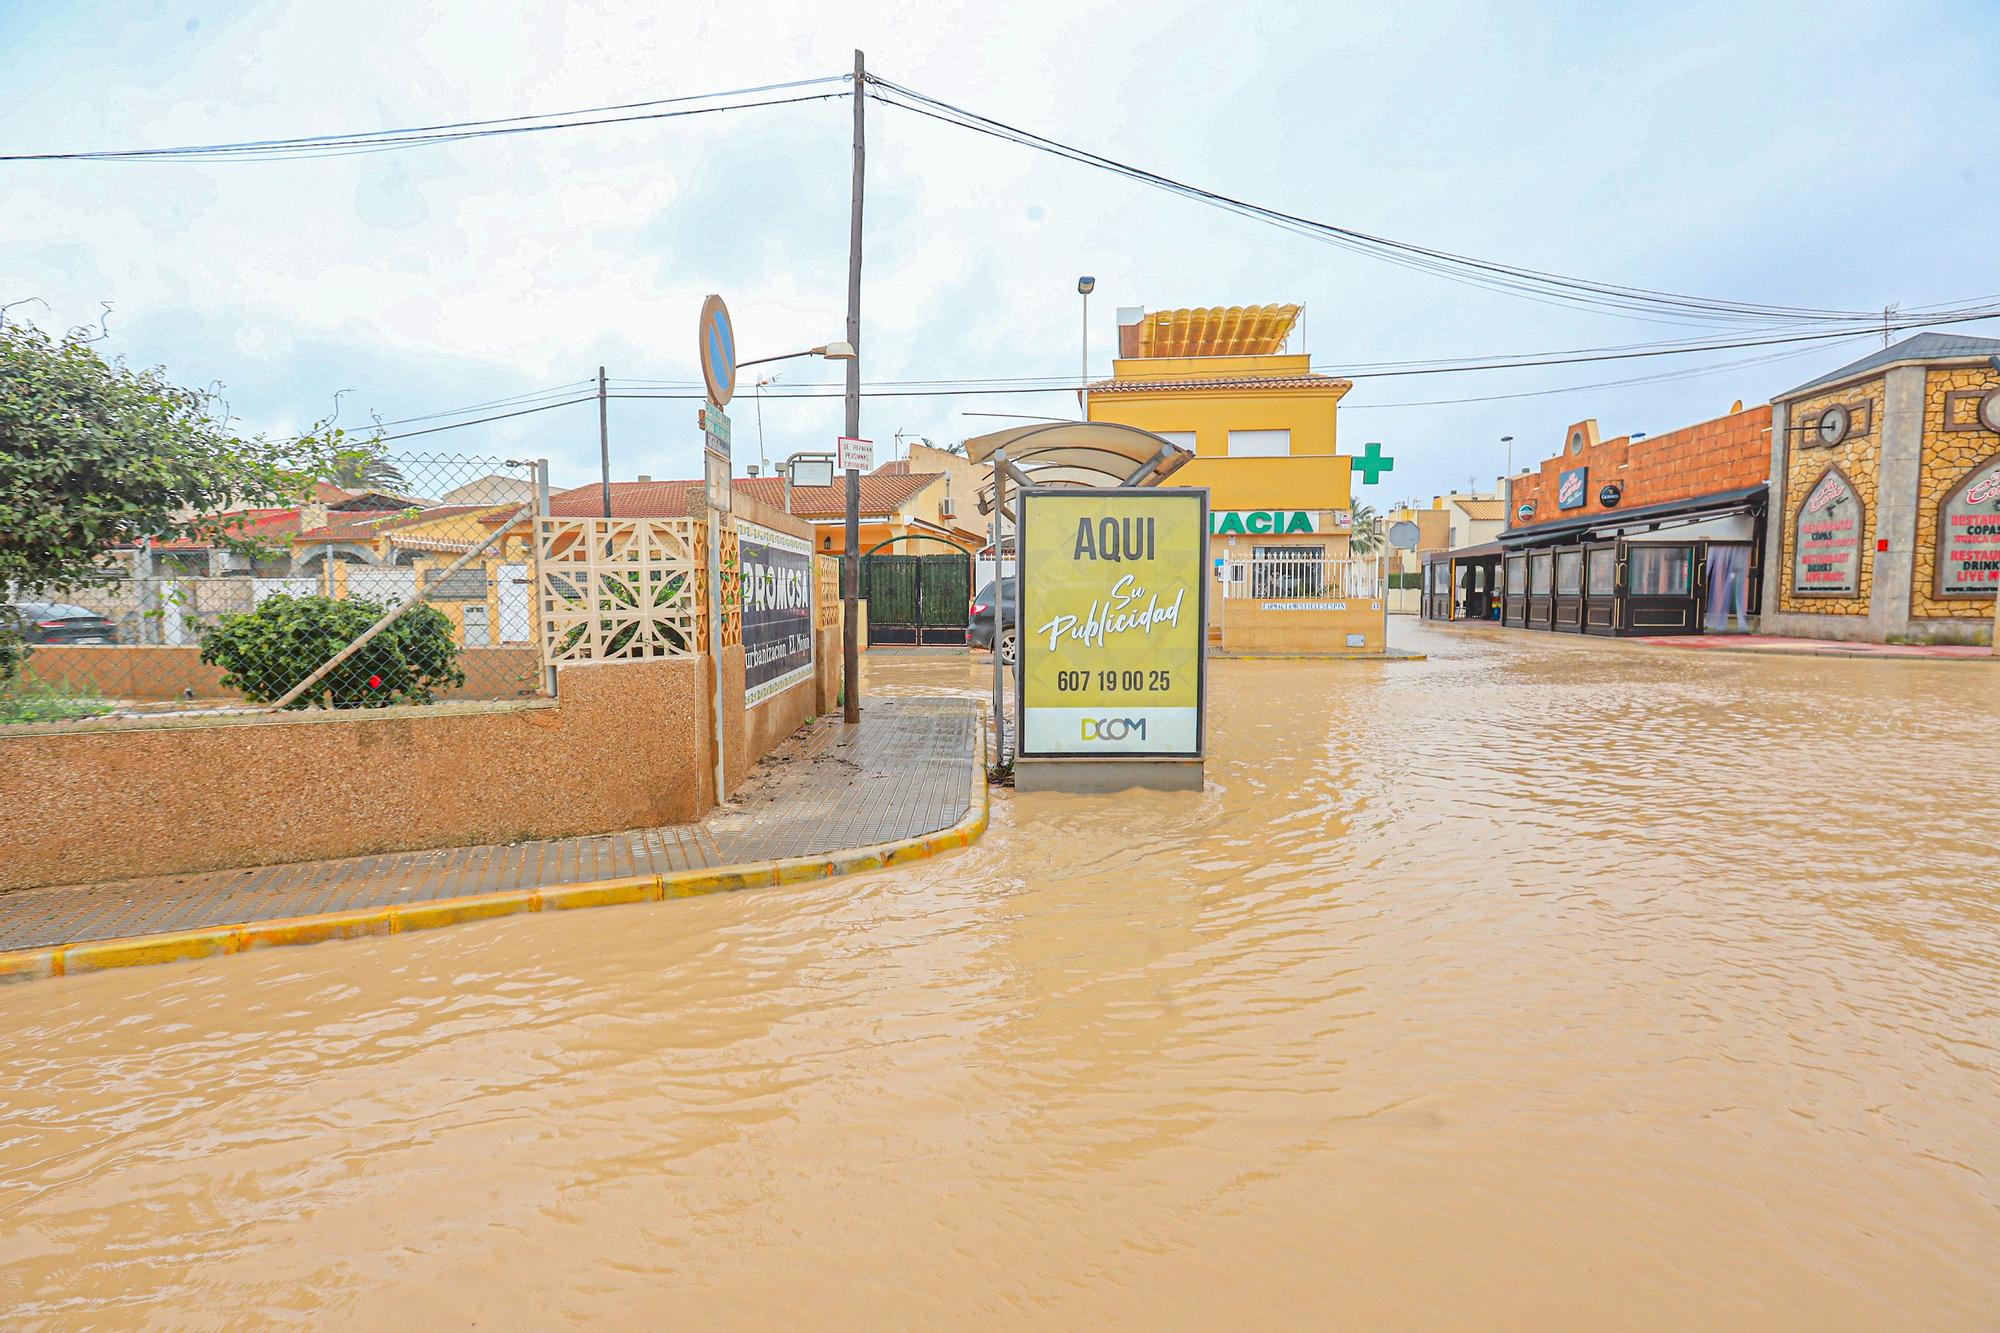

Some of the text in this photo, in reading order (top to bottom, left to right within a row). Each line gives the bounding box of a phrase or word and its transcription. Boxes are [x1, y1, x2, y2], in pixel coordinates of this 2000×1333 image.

[1073, 517, 1155, 563] AQUI
[743, 561, 809, 612] PROMOSA
[1111, 574, 1146, 610] Su
[1956, 571, 1984, 582] LIVE
[1038, 588, 1185, 652] Publicidad
[1057, 670, 1170, 692] 607 19 00 25
